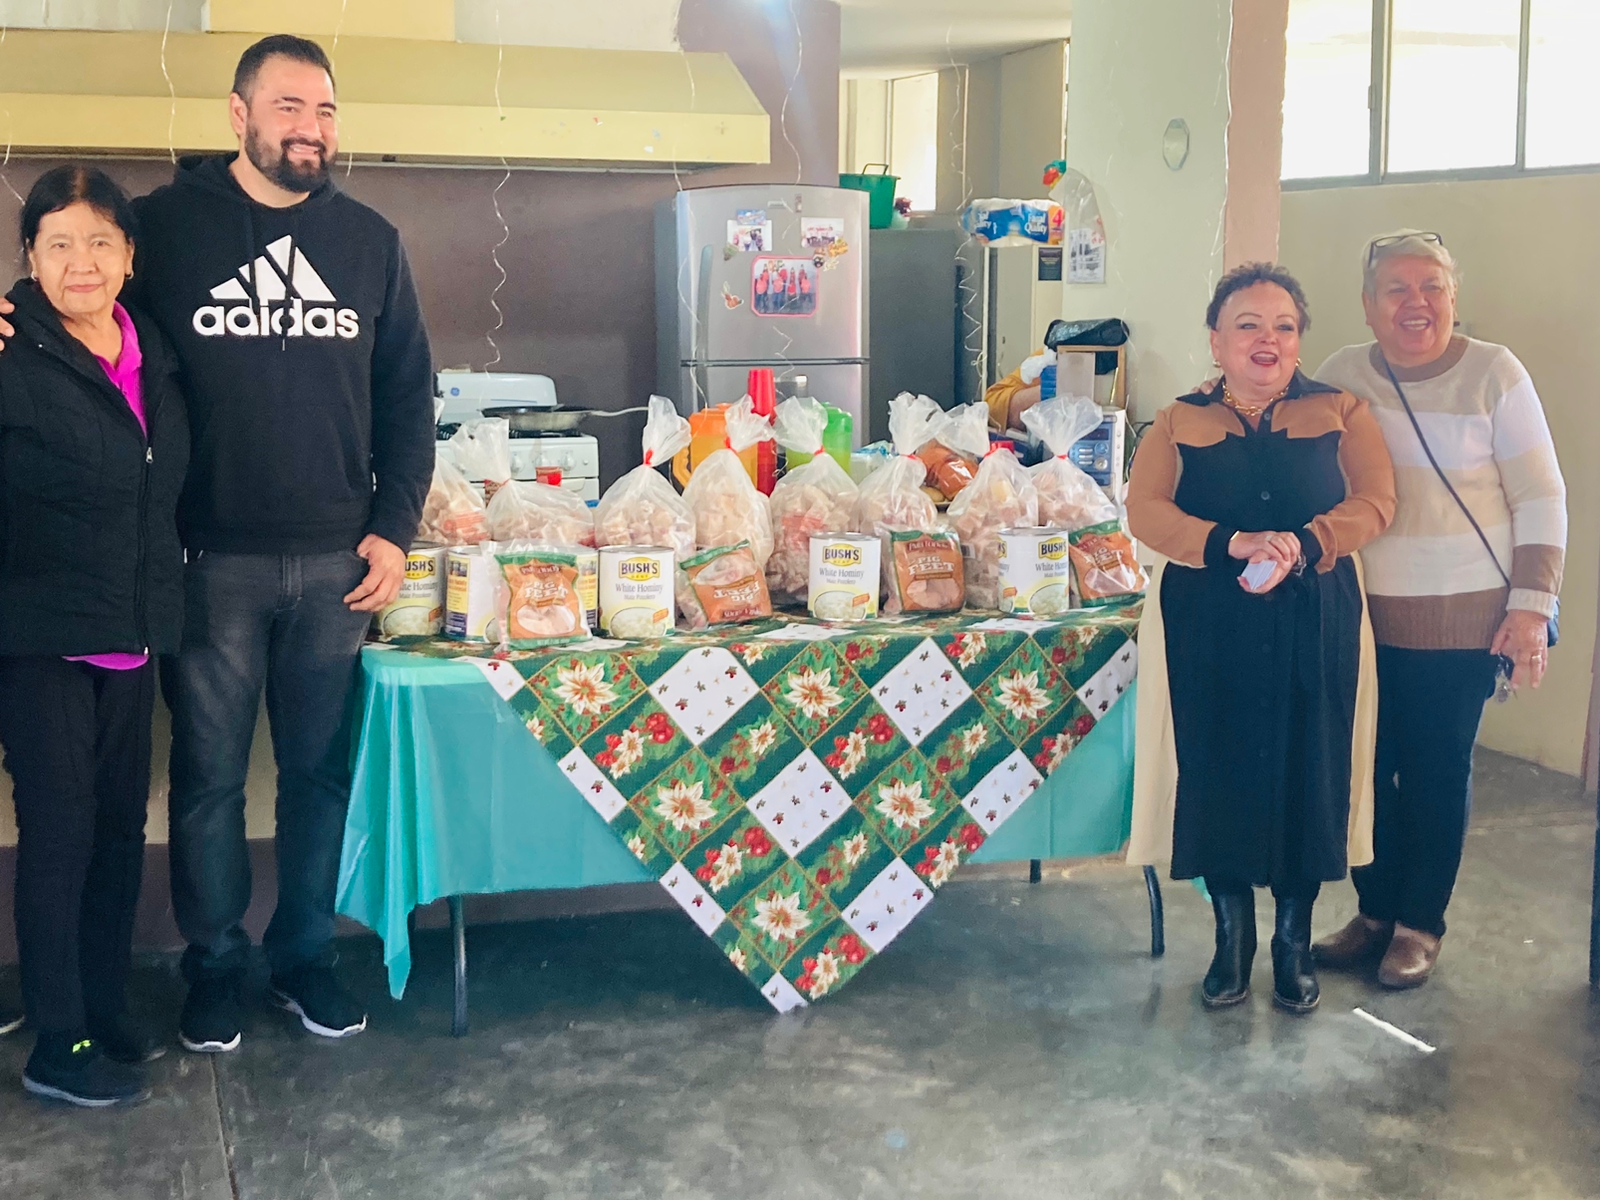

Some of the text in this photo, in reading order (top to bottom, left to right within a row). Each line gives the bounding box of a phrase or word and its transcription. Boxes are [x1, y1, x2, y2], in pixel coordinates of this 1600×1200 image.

[1052, 208, 1063, 228] 4
[1024, 221, 1048, 235] Quality
[193, 297, 360, 338] adidas
[825, 548, 860, 561] BUSH'S
[1041, 542, 1067, 556] BUSH'S
[404, 560, 434, 572] USH'S
[918, 556, 941, 564] PIG
[1035, 562, 1054, 571] White
[621, 562, 658, 575] BUSH'S
[819, 567, 865, 580] White Hominy
[908, 561, 954, 575] FEET
[525, 585, 568, 598] FEET
[533, 581, 555, 590] PIG
[615, 583, 663, 594] White Hominy
[713, 581, 760, 599] FEET
